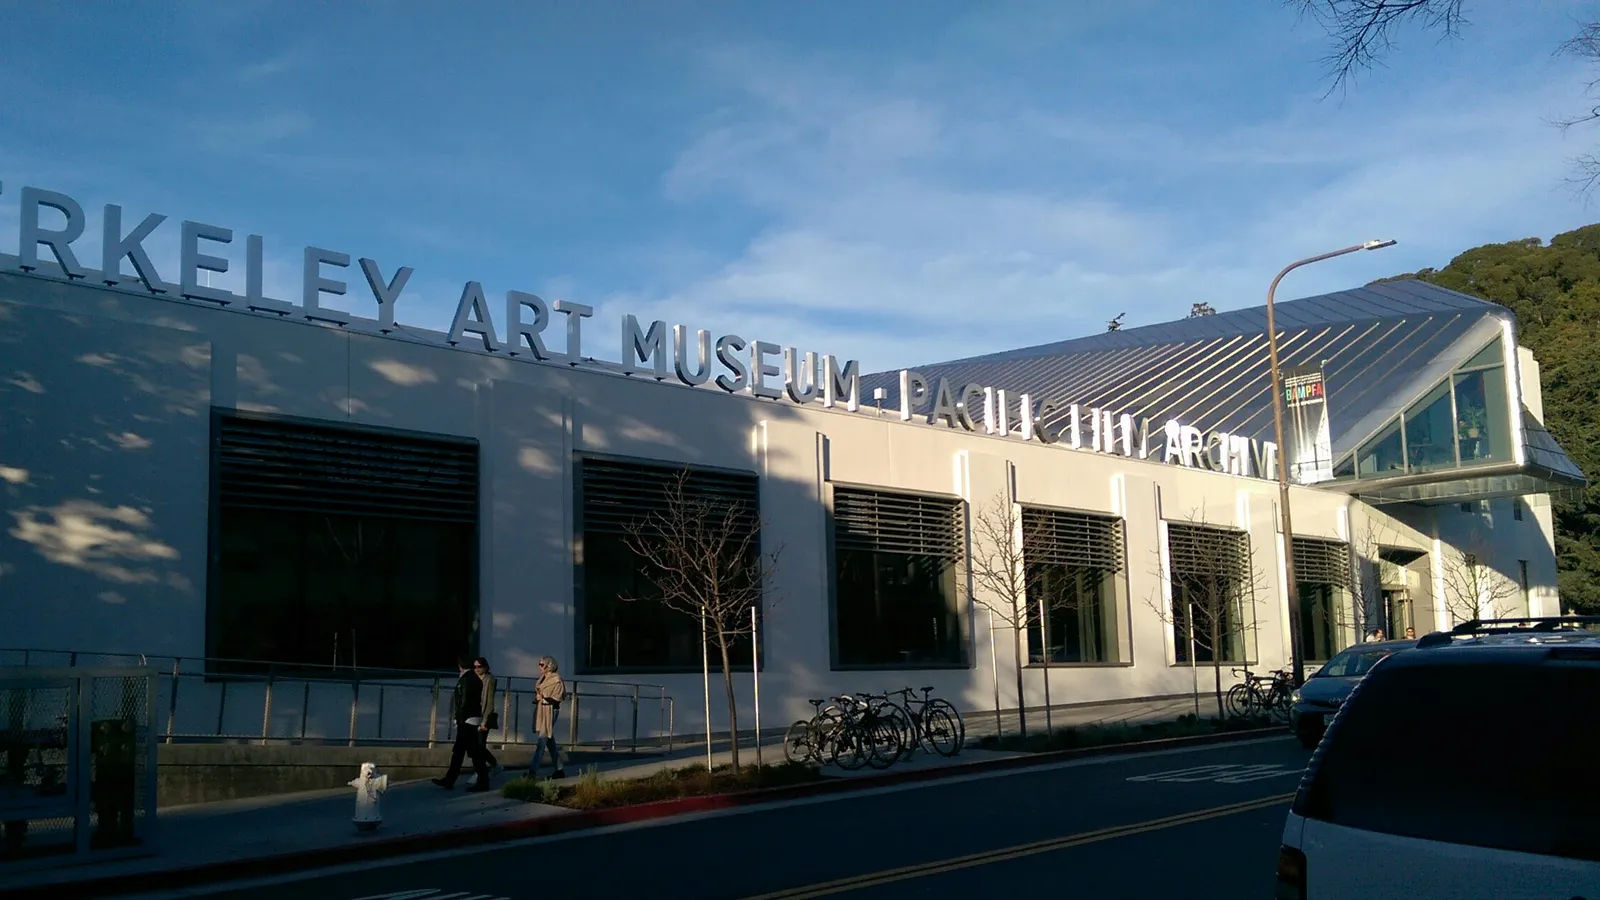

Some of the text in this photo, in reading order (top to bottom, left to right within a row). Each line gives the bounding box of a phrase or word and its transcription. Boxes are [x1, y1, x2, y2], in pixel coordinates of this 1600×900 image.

[0, 181, 413, 332] RKELEY
[446, 281, 592, 365] ART
[622, 314, 859, 412] MUSEUM
[900, 369, 1059, 444] PACIFIC
[1070, 404, 1150, 459] FILM
[1286, 383, 1323, 401] BAMPFA
